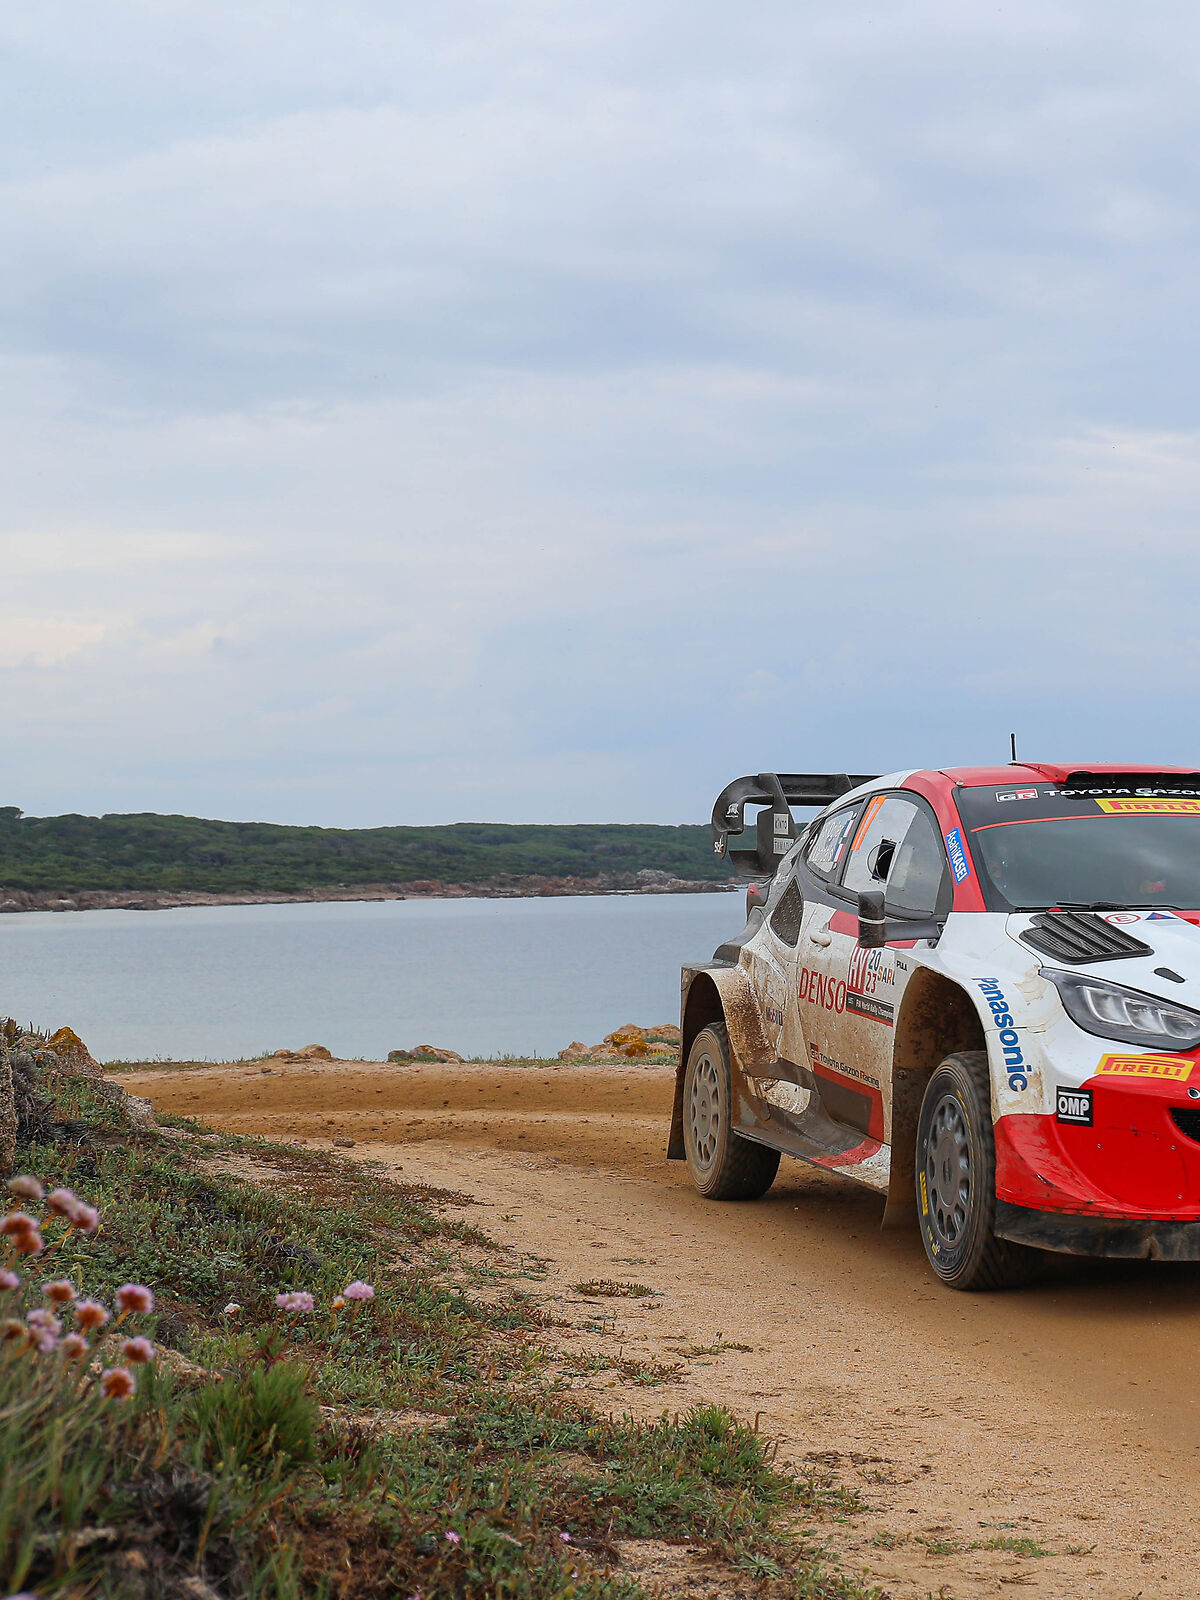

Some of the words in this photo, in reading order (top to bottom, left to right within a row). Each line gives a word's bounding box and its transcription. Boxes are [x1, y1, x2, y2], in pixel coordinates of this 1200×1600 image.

[999, 790, 1038, 801] GR
[1044, 788, 1131, 797] TOYOTA
[1108, 800, 1200, 811] PIRELLI
[868, 950, 882, 971] 20
[798, 967, 848, 1014] DENSO
[865, 971, 878, 994] 23
[971, 977, 1033, 1093] Panasonic
[1102, 1057, 1186, 1077] PIRELLI
[1058, 1096, 1090, 1116] OMP
